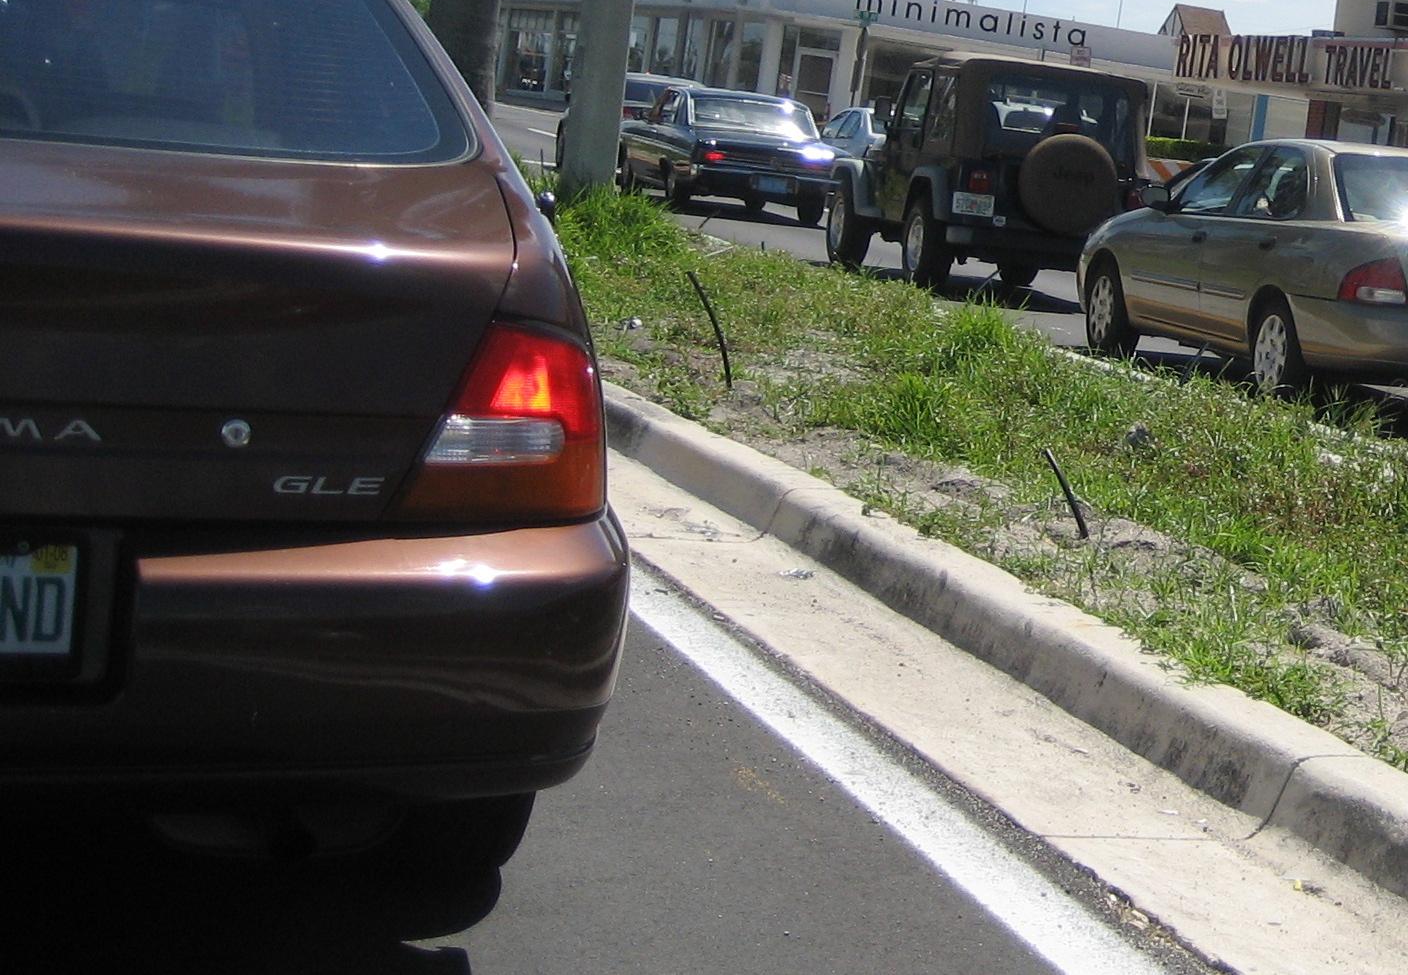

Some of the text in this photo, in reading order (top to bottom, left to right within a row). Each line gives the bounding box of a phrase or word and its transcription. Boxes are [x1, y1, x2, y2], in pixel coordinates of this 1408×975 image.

[1175, 33, 1393, 90] RITA OLWELL TRAVEL
[272, 475, 385, 496] GLE
